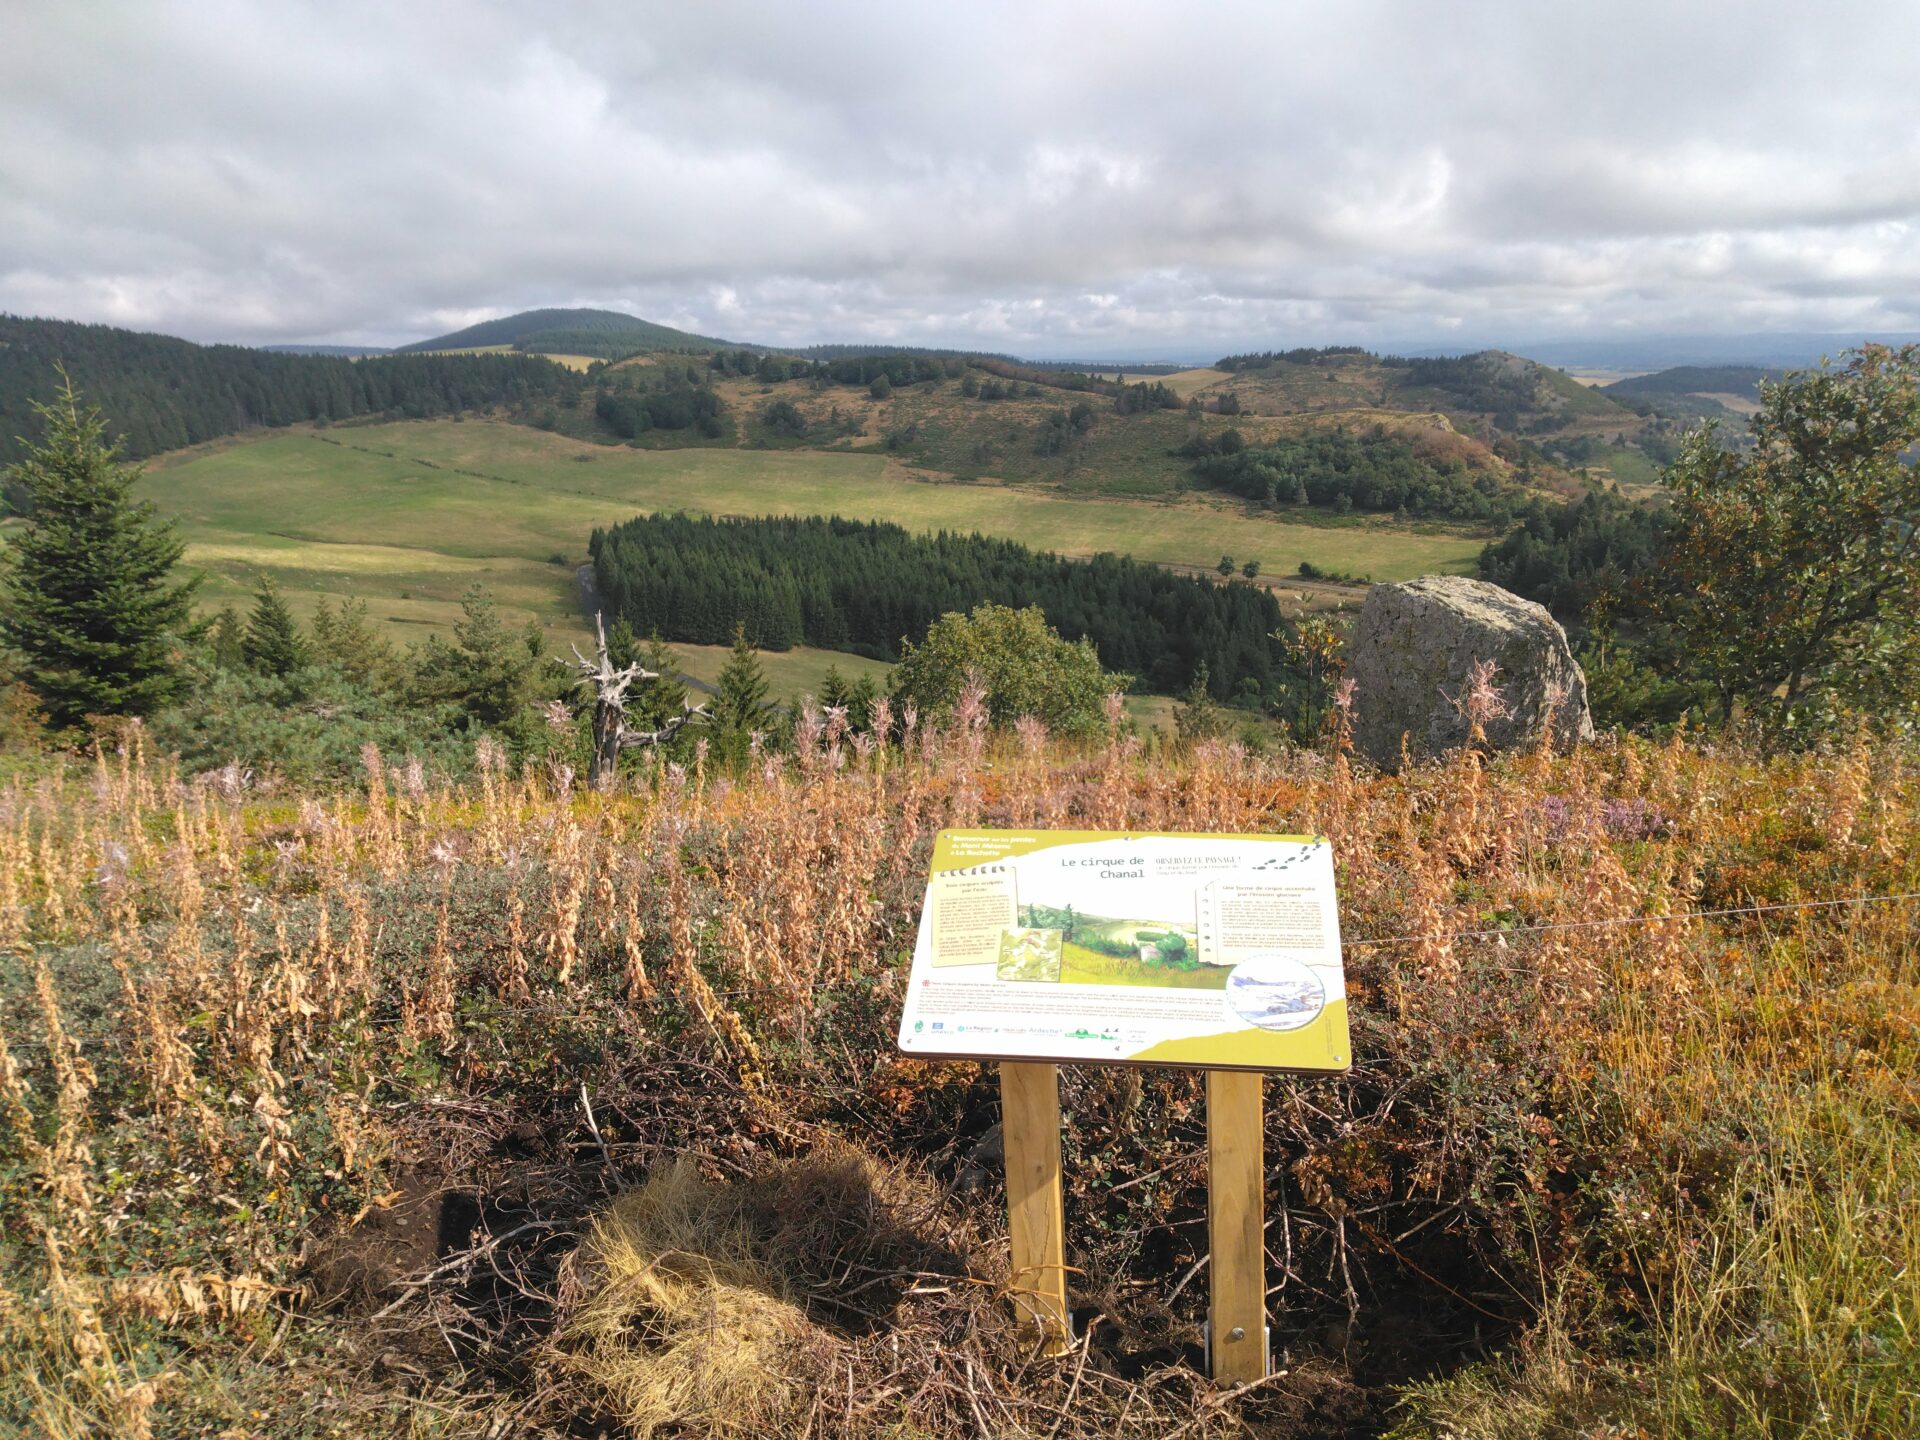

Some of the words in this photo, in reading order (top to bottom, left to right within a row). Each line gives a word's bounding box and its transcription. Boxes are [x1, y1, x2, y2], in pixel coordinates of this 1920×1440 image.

[1061, 858, 1076, 867] Le
[1081, 857, 1125, 868] cirque
[1129, 856, 1145, 865] de
[1100, 869, 1145, 879] Chanal
